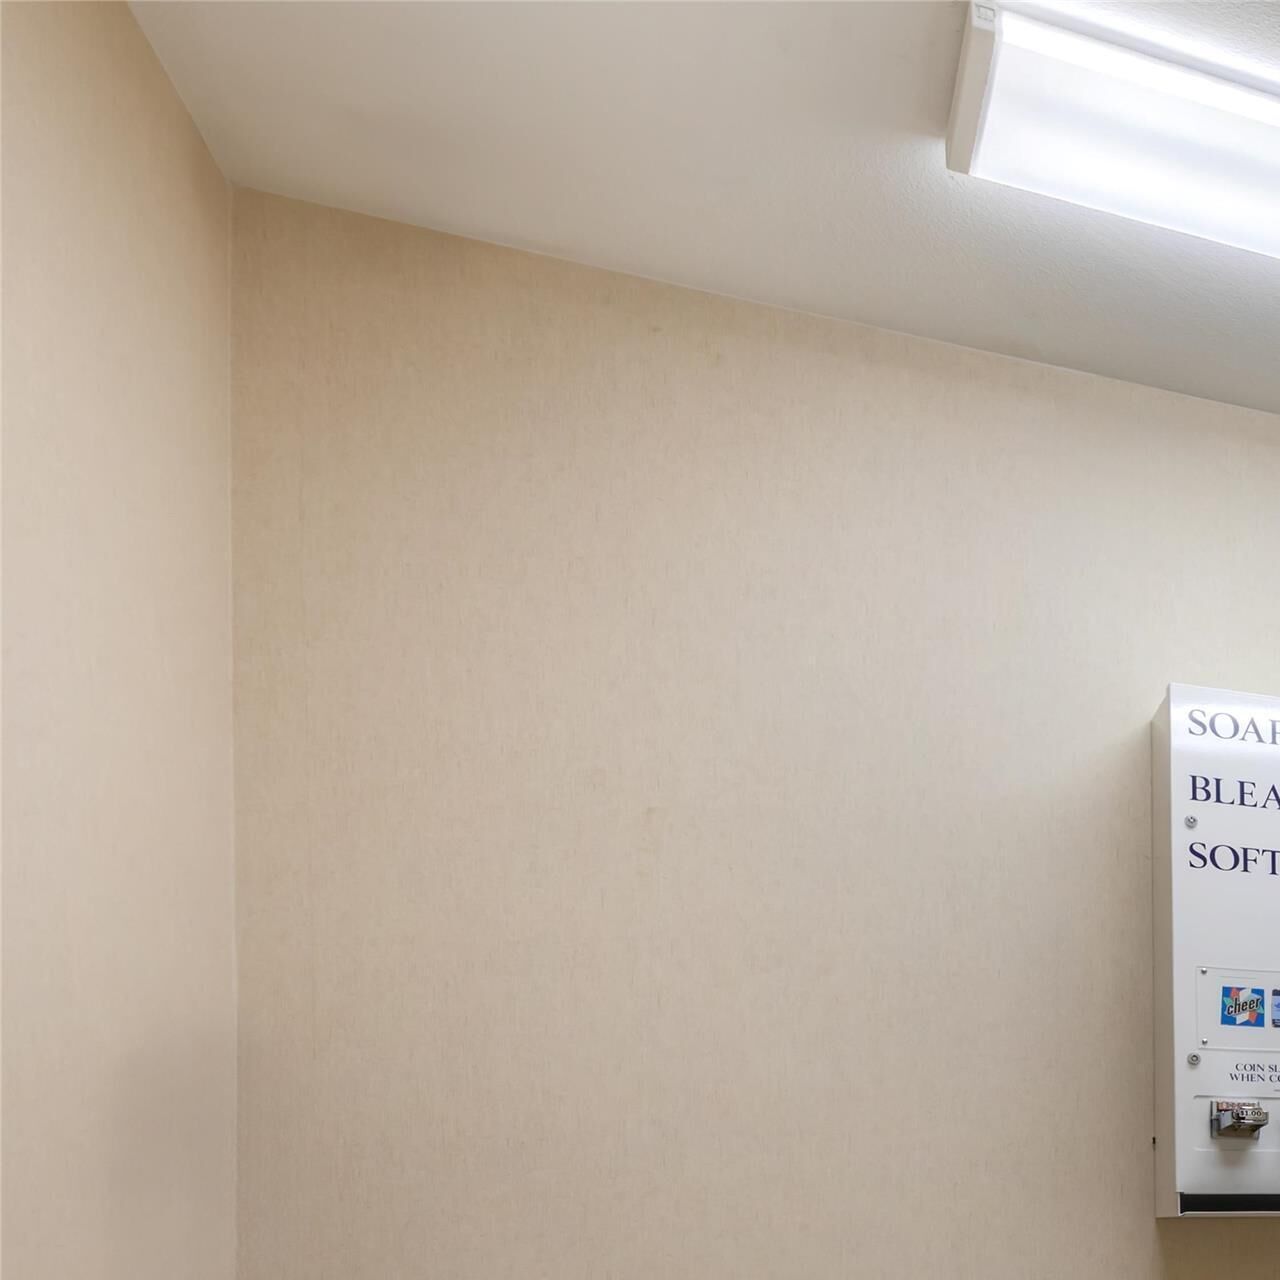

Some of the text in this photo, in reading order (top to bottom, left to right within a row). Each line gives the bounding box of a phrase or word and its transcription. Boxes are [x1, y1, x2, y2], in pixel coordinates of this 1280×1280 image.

[1227, 997, 1262, 1015] cheer
[1235, 1063, 1265, 1072] COIN
[1230, 1073, 1265, 1082] WHEN
